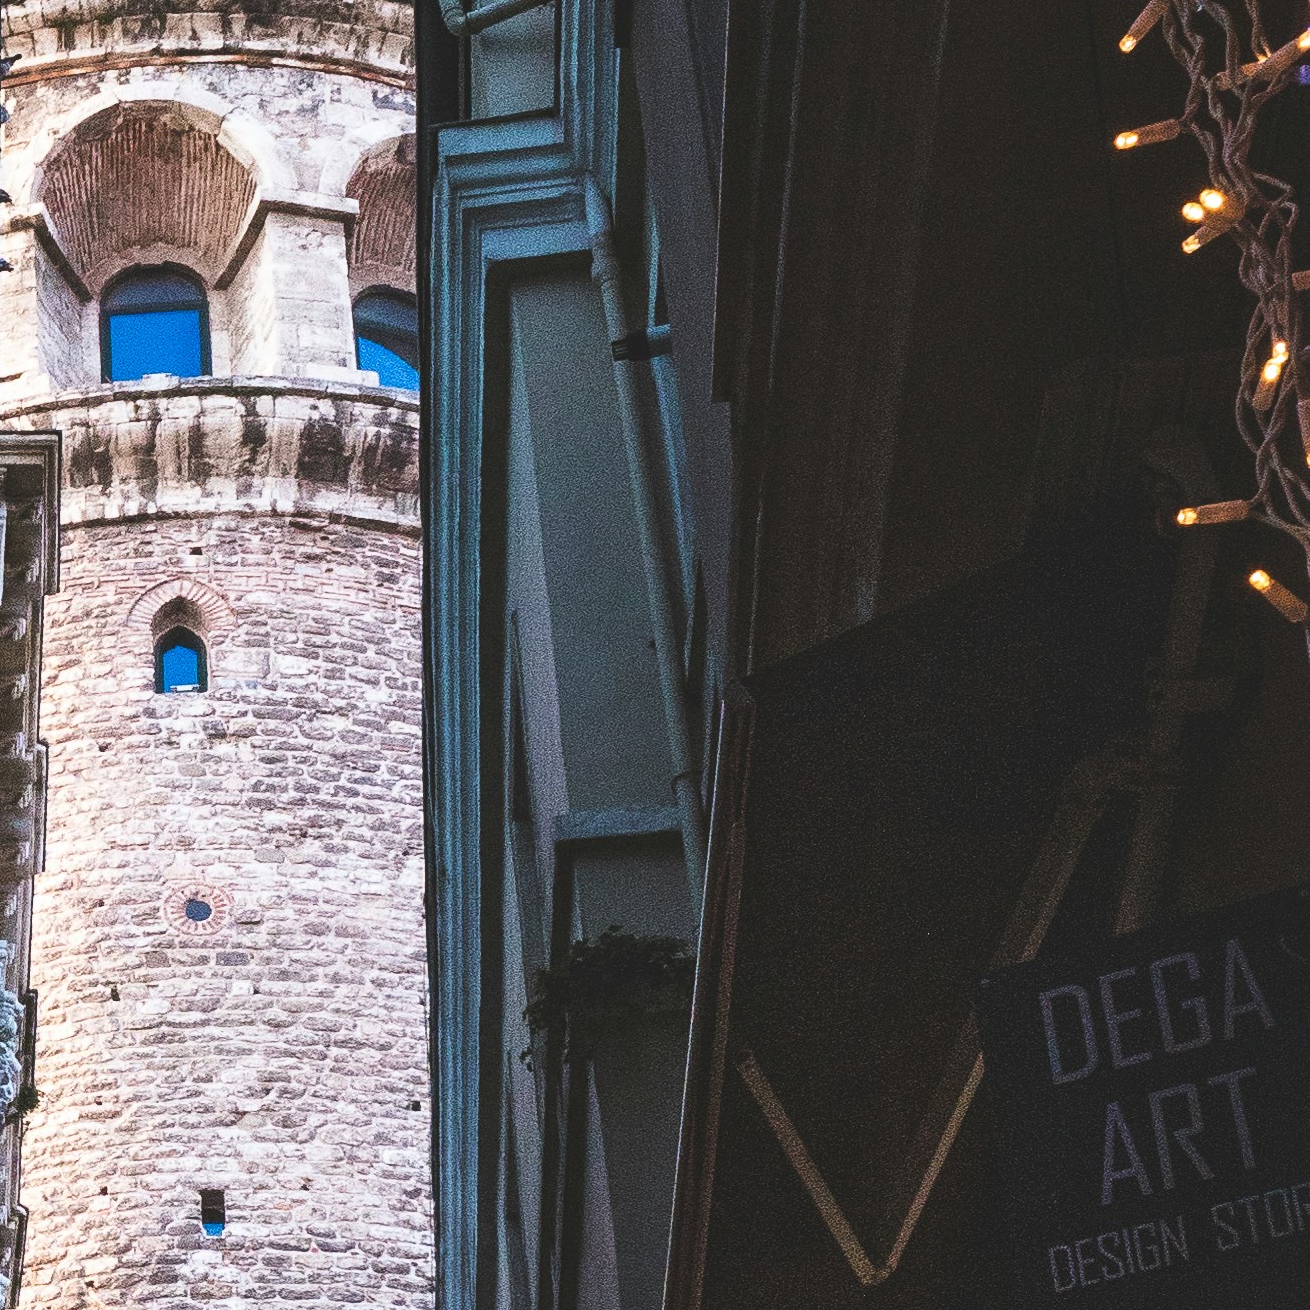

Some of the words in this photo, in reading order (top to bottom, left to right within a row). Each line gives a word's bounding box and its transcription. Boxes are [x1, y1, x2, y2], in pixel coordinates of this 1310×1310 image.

[1038, 937, 1276, 1086] DEGA
[1099, 1066, 1258, 1207] ART
[1048, 1215, 1189, 1293] DESIGN
